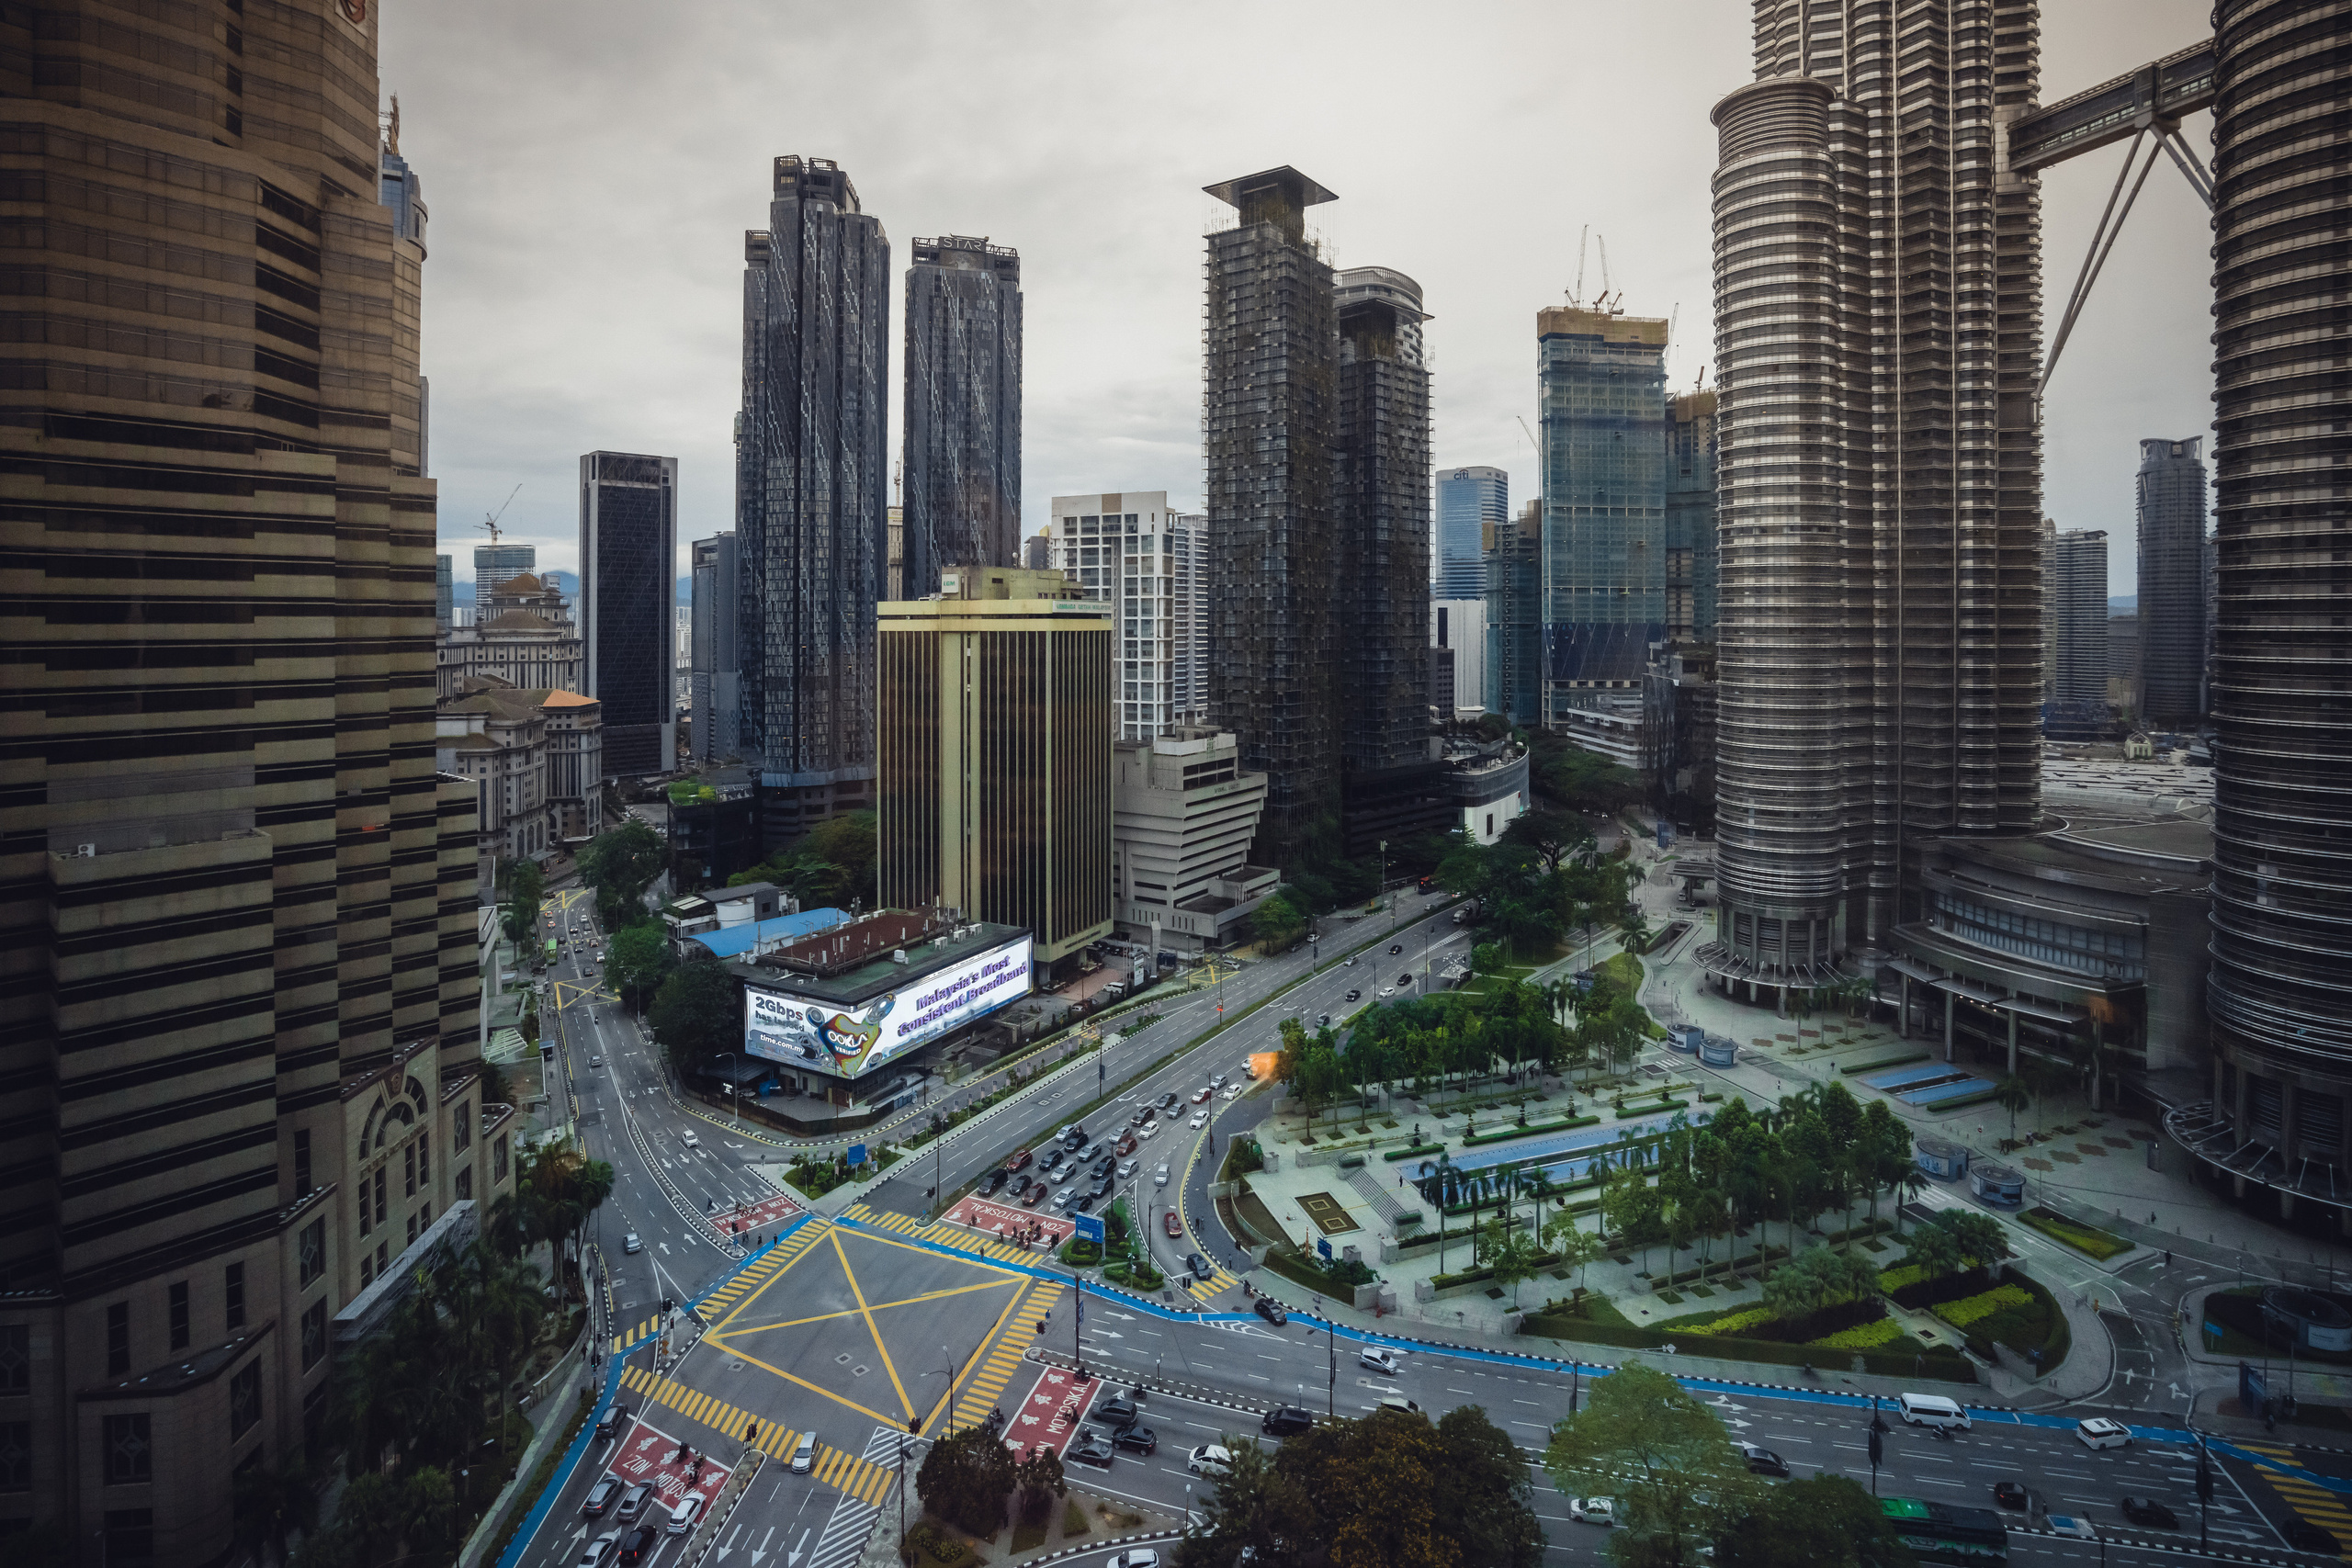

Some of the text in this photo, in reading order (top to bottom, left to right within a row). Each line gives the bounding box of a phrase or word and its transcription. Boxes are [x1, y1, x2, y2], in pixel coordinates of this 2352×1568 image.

[944, 238, 981, 251] STAR
[1453, 470, 1468, 480] citi
[916, 971, 980, 1010] Malaysia's
[981, 955, 1011, 979] Most
[898, 993, 967, 1037] Consistent
[967, 961, 1028, 1002] Broadband
[755, 996, 804, 1021] 2Gbps
[755, 1010, 772, 1022] has
[760, 1033, 806, 1055] time.com.my
[828, 1032, 868, 1048] OOKLA
[835, 1044, 862, 1055] VERIFIED
[767, 1198, 787, 1209] ZON
[969, 1201, 1066, 1233] ZON MOTOSIKAL
[622, 1454, 653, 1475] ZON
